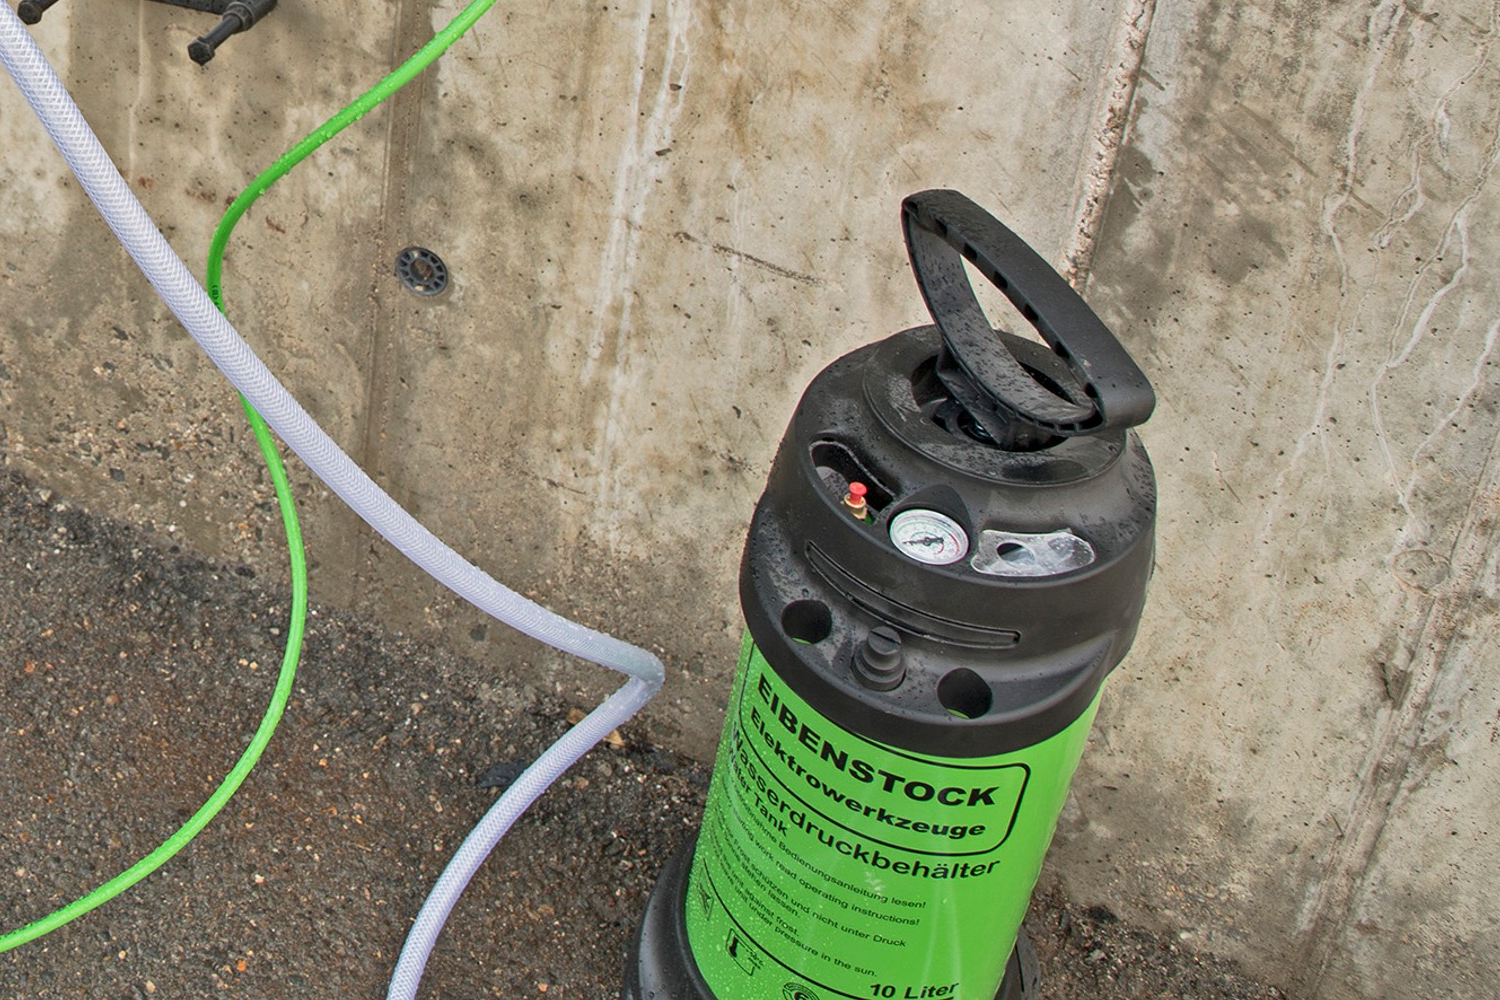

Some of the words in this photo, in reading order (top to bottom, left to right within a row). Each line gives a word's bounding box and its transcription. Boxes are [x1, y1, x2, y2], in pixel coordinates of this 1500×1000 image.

[751, 706, 986, 840] Elektrowerkzeuge
[758, 672, 1000, 807] EIBENSTOCK
[733, 720, 1001, 880] Wasserdruckbehälter
[754, 791, 788, 837] Tank
[775, 860, 798, 881] read
[799, 877, 849, 910] operating
[851, 904, 921, 926] instructions!
[779, 840, 889, 904] Bedienungsanleitung
[891, 896, 927, 909] lesen!
[748, 902, 773, 927] under
[774, 926, 820, 956] pressure
[821, 952, 831, 963] in
[833, 958, 852, 970] the
[791, 897, 810, 914] und
[812, 909, 840, 929] nicht
[841, 924, 871, 940] unter
[873, 934, 907, 947] Druck
[870, 983, 896, 999] 10
[903, 982, 960, 1000] Liter
